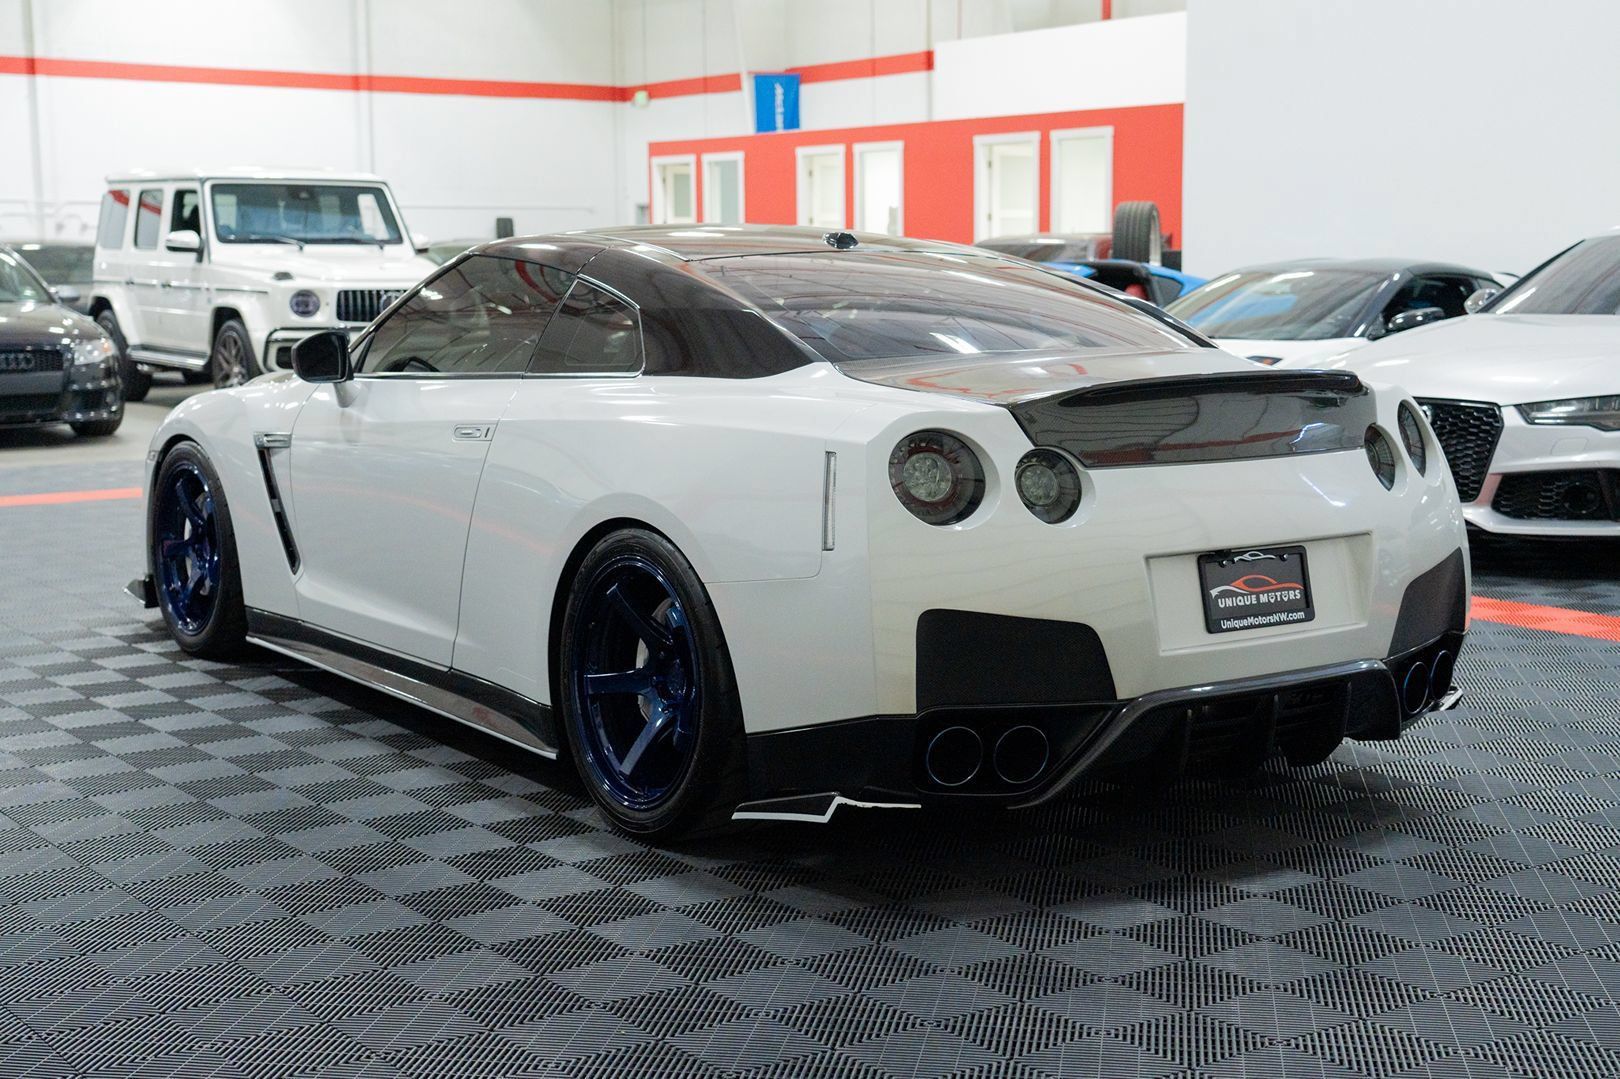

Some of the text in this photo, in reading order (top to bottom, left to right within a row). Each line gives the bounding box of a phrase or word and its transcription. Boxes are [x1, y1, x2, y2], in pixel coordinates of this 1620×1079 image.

[1218, 590, 1301, 608] UNIQUE MOTORS
[1220, 611, 1305, 629] UniqueMotorsNW.com
